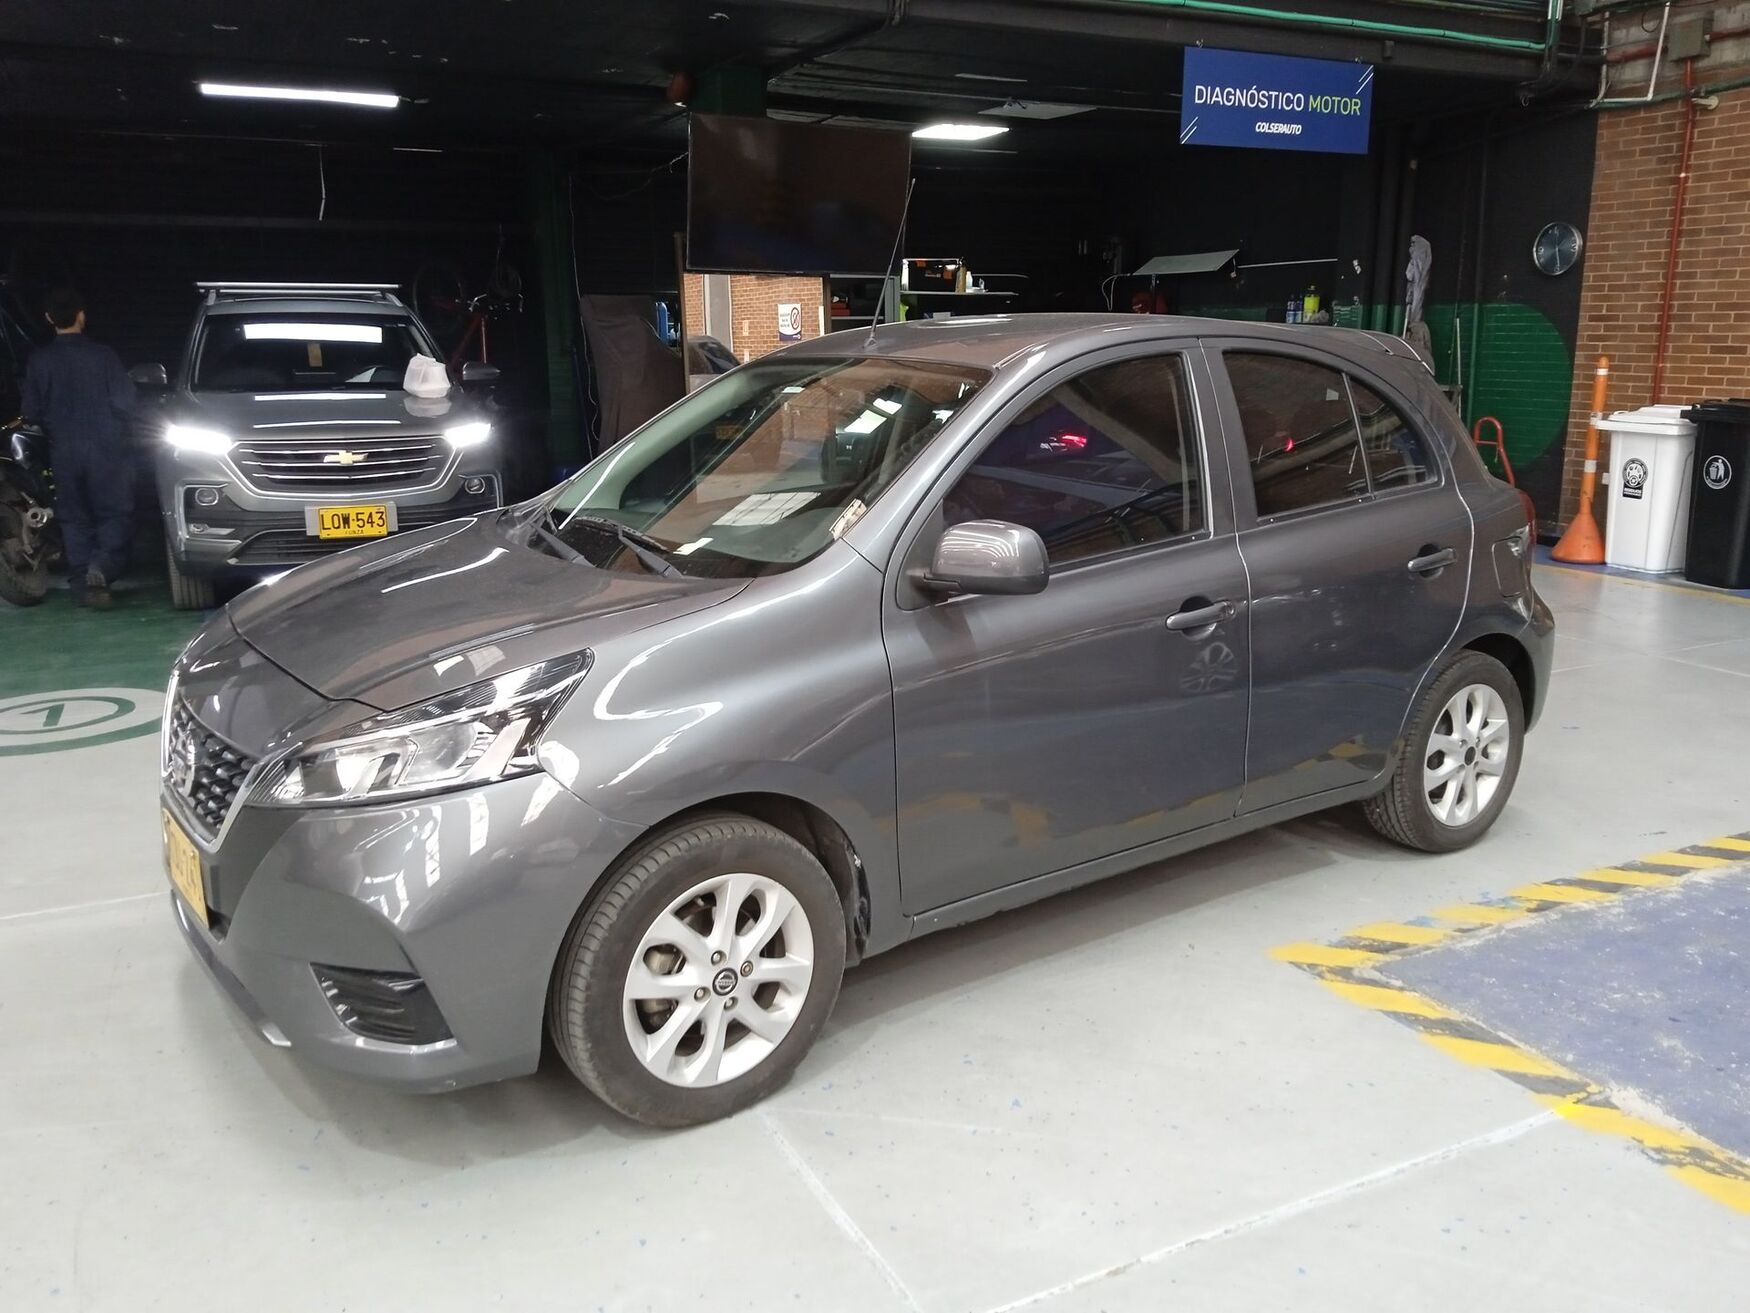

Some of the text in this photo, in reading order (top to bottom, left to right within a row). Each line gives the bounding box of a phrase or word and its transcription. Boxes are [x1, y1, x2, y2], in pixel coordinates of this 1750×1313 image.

[1195, 85, 1361, 116] DIAGNÓSTICO MOTOR
[1255, 122, 1302, 135] COLSERAUTO
[20, 703, 65, 727] 1
